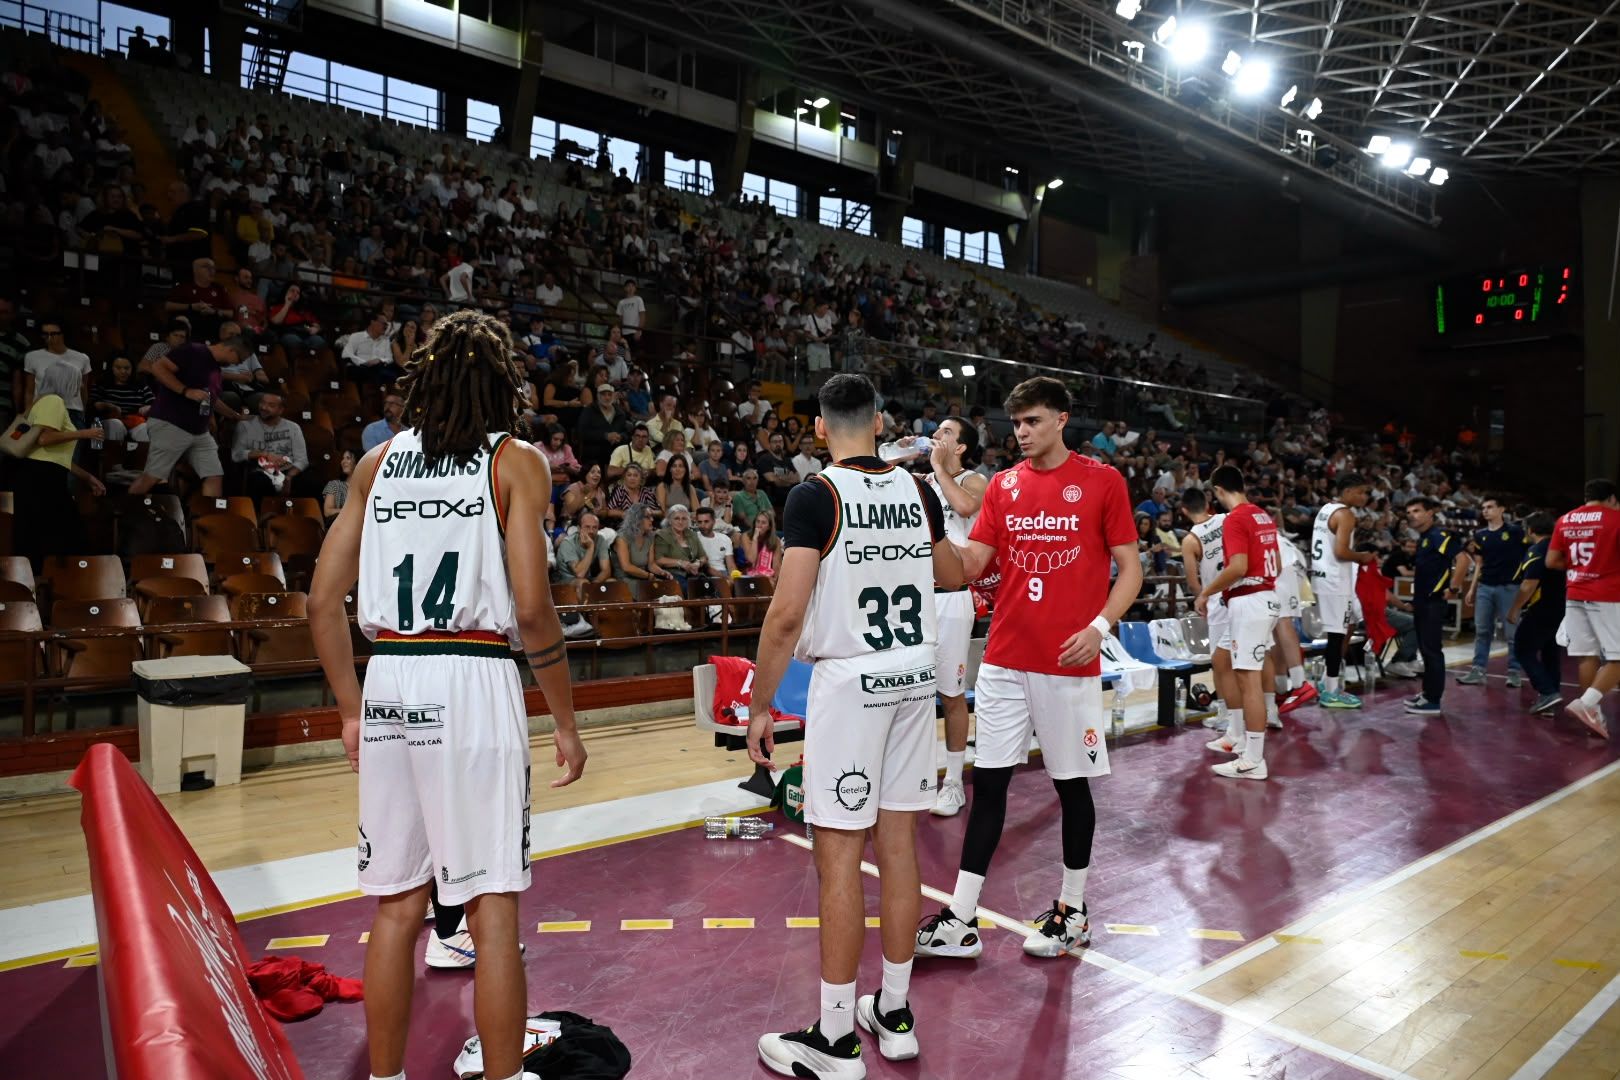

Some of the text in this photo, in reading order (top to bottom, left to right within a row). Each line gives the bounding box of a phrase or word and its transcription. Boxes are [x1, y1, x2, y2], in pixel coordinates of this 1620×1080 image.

[1483, 279, 1492, 292] 0
[1519, 274, 1528, 287] 0
[1475, 313, 1484, 324] 0
[1515, 309, 1523, 320] 0
[374, 496, 485, 523] Geoxa
[844, 503, 922, 530] LLAMAS
[1005, 510, 1080, 532] Ezedent
[845, 540, 932, 564] Geoxa
[1263, 548, 1278, 577] 10
[1569, 542, 1595, 566] 15
[393, 551, 460, 631] 14
[1028, 577, 1043, 602] 9
[858, 584, 924, 651] 33
